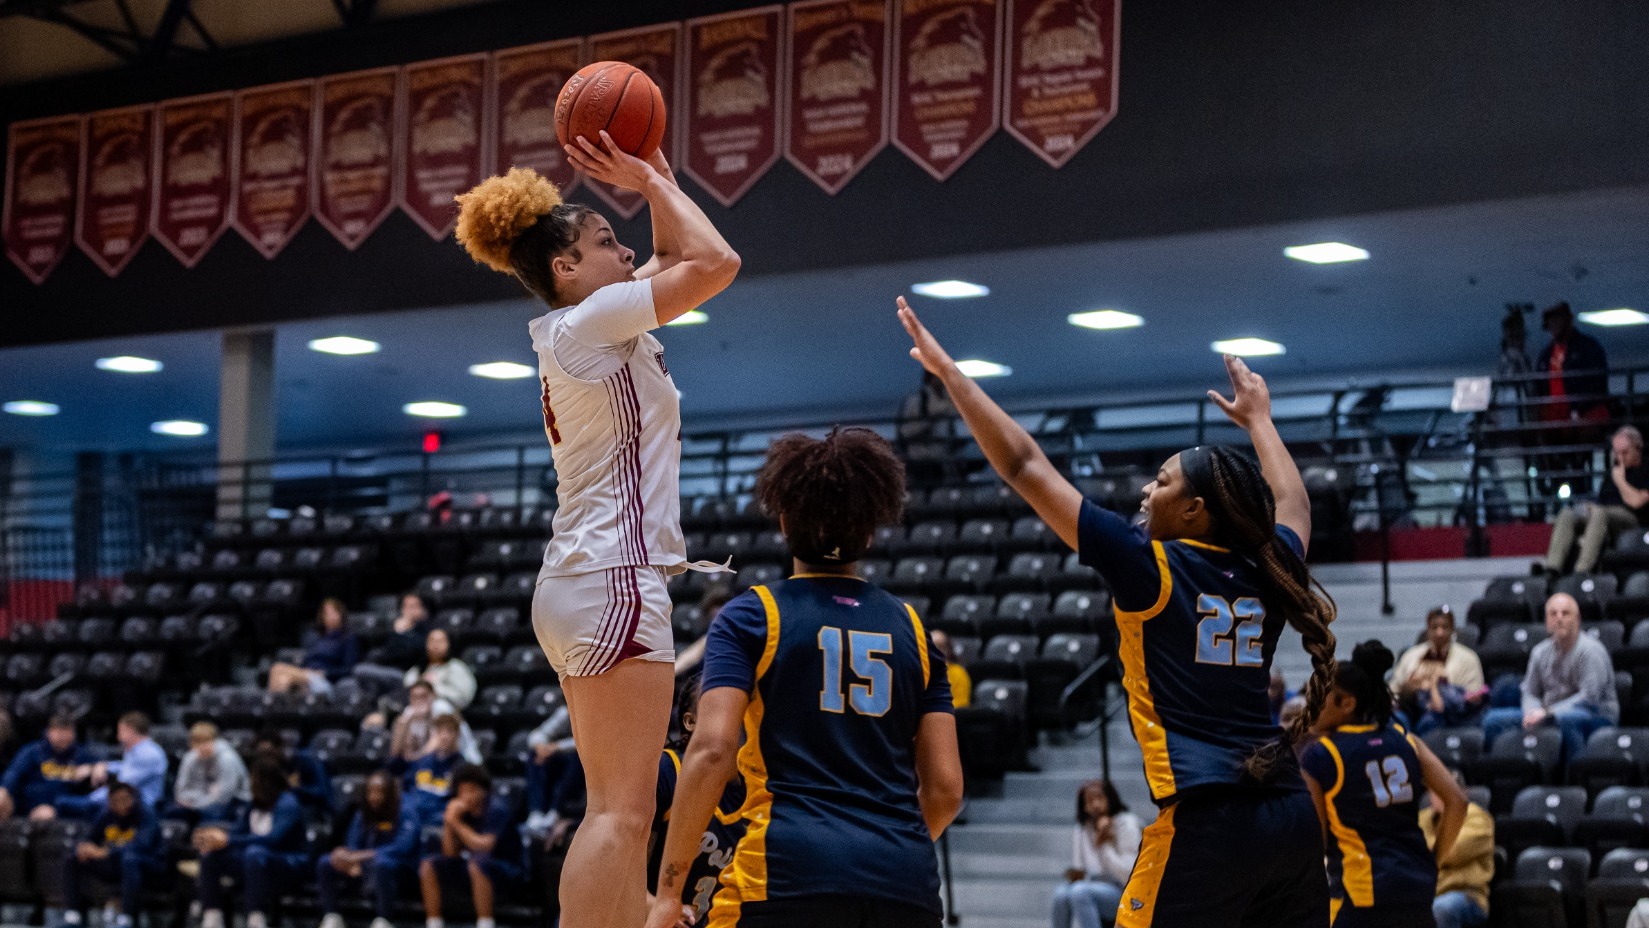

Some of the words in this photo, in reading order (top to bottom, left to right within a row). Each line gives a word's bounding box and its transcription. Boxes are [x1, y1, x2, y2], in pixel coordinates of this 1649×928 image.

[1195, 593, 1266, 668] 22
[817, 626, 893, 718] 15
[1364, 755, 1413, 808] 12
[692, 875, 718, 924] 3
